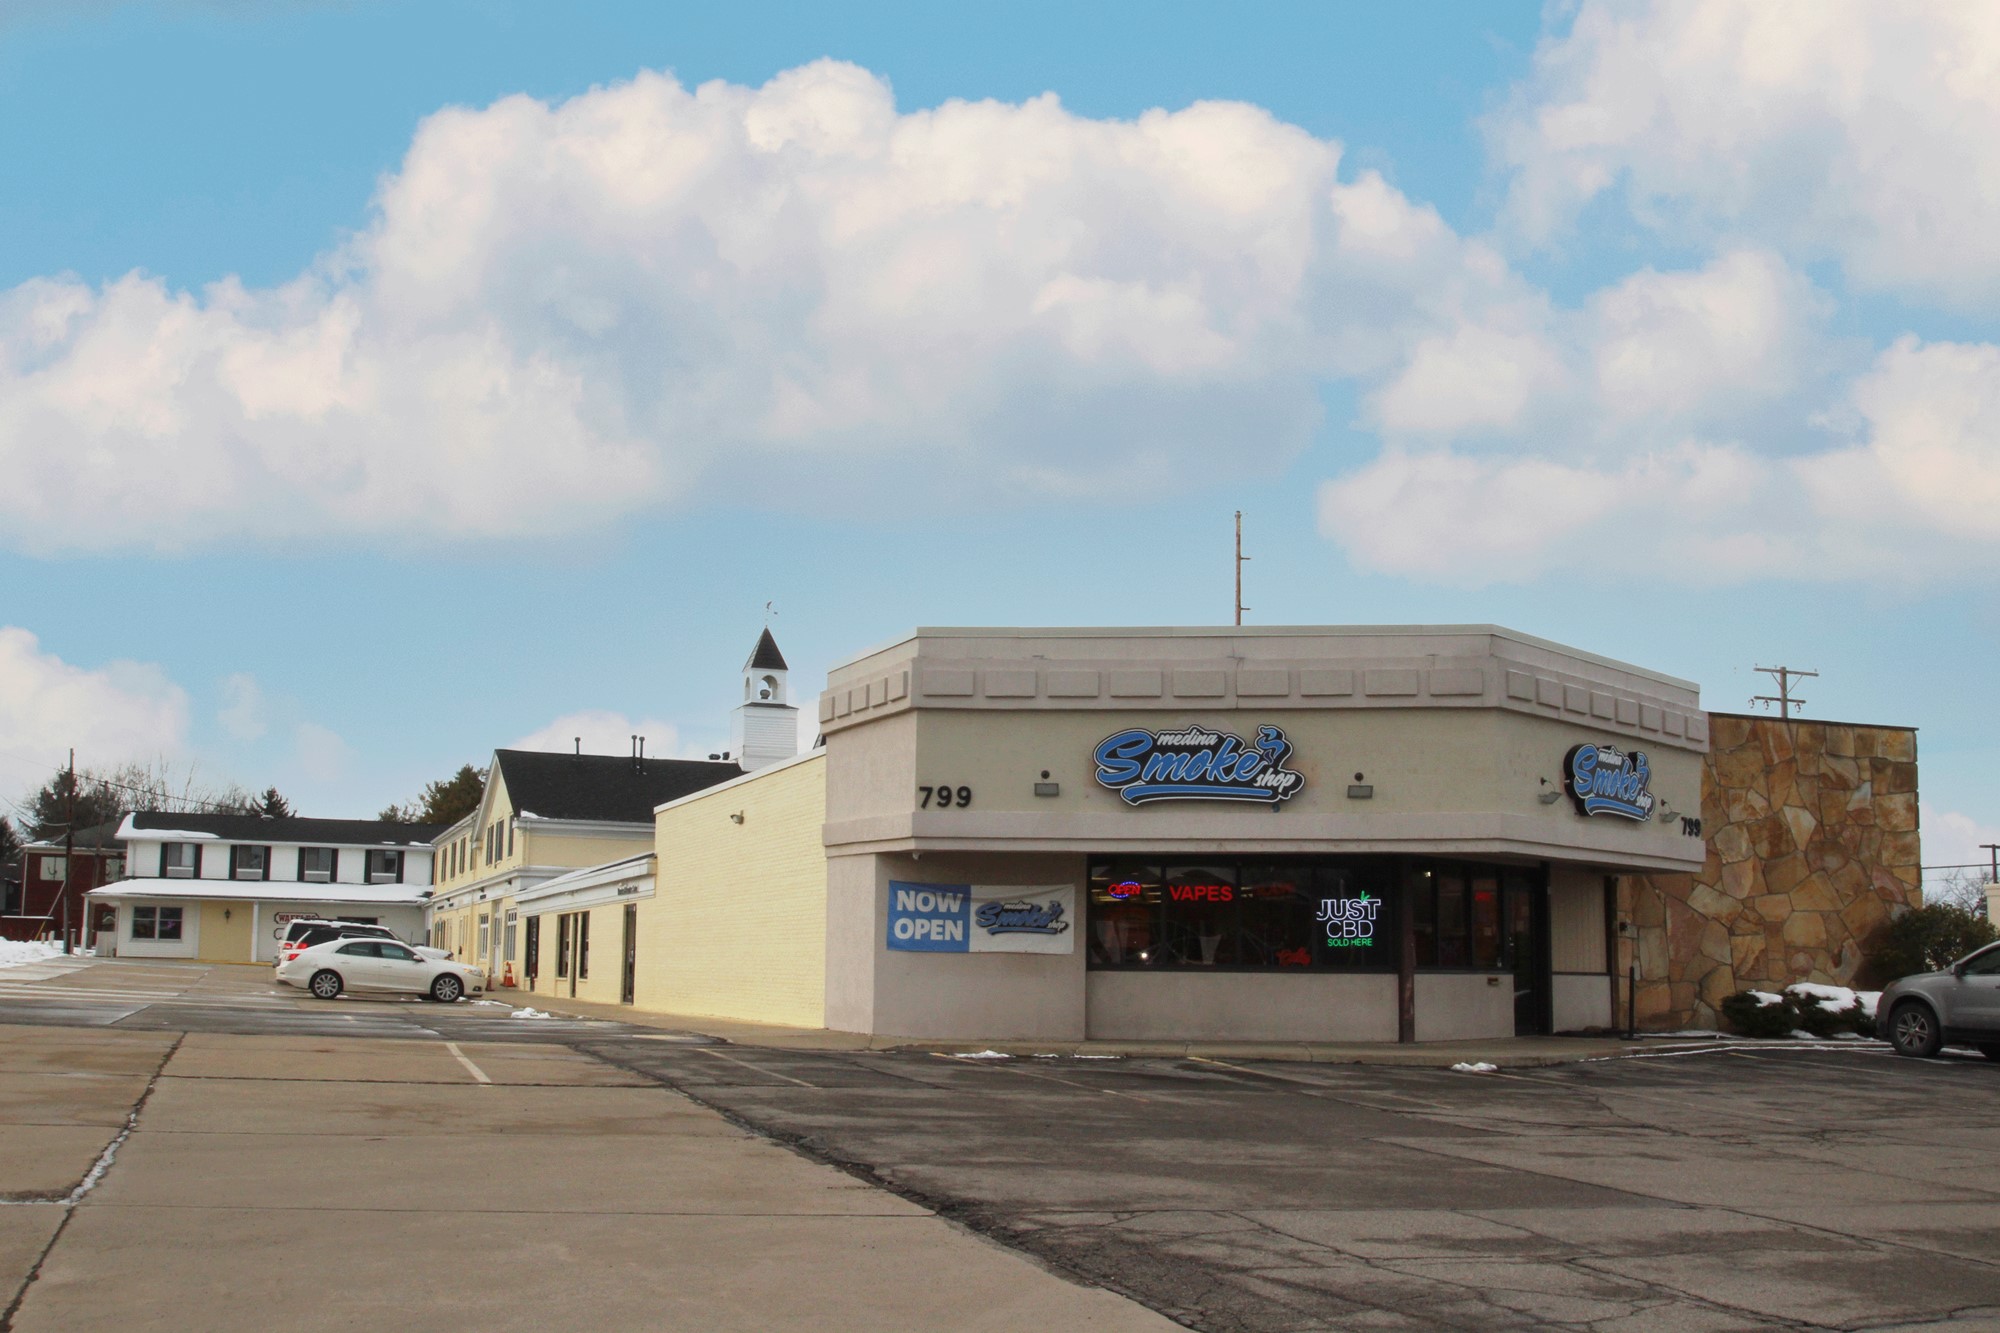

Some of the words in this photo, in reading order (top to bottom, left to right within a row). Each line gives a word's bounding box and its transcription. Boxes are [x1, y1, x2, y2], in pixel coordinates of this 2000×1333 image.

[1157, 729, 1218, 746] medina
[1096, 730, 1267, 783] Smoke
[1252, 768, 1297, 793] shop
[1573, 744, 1641, 800] Smoke
[919, 785, 972, 809] 799
[1681, 816, 1702, 836] 799
[897, 889, 963, 913] NOW
[1108, 883, 1141, 896] OPEN
[1169, 885, 1233, 901] VAPES
[975, 900, 1054, 928] Smoke
[1316, 898, 1381, 921] JUST
[894, 918, 963, 941] OPEN
[1326, 919, 1373, 938] CBD
[1327, 938, 1349, 947] SOLD
[1350, 938, 1373, 947] HERE
